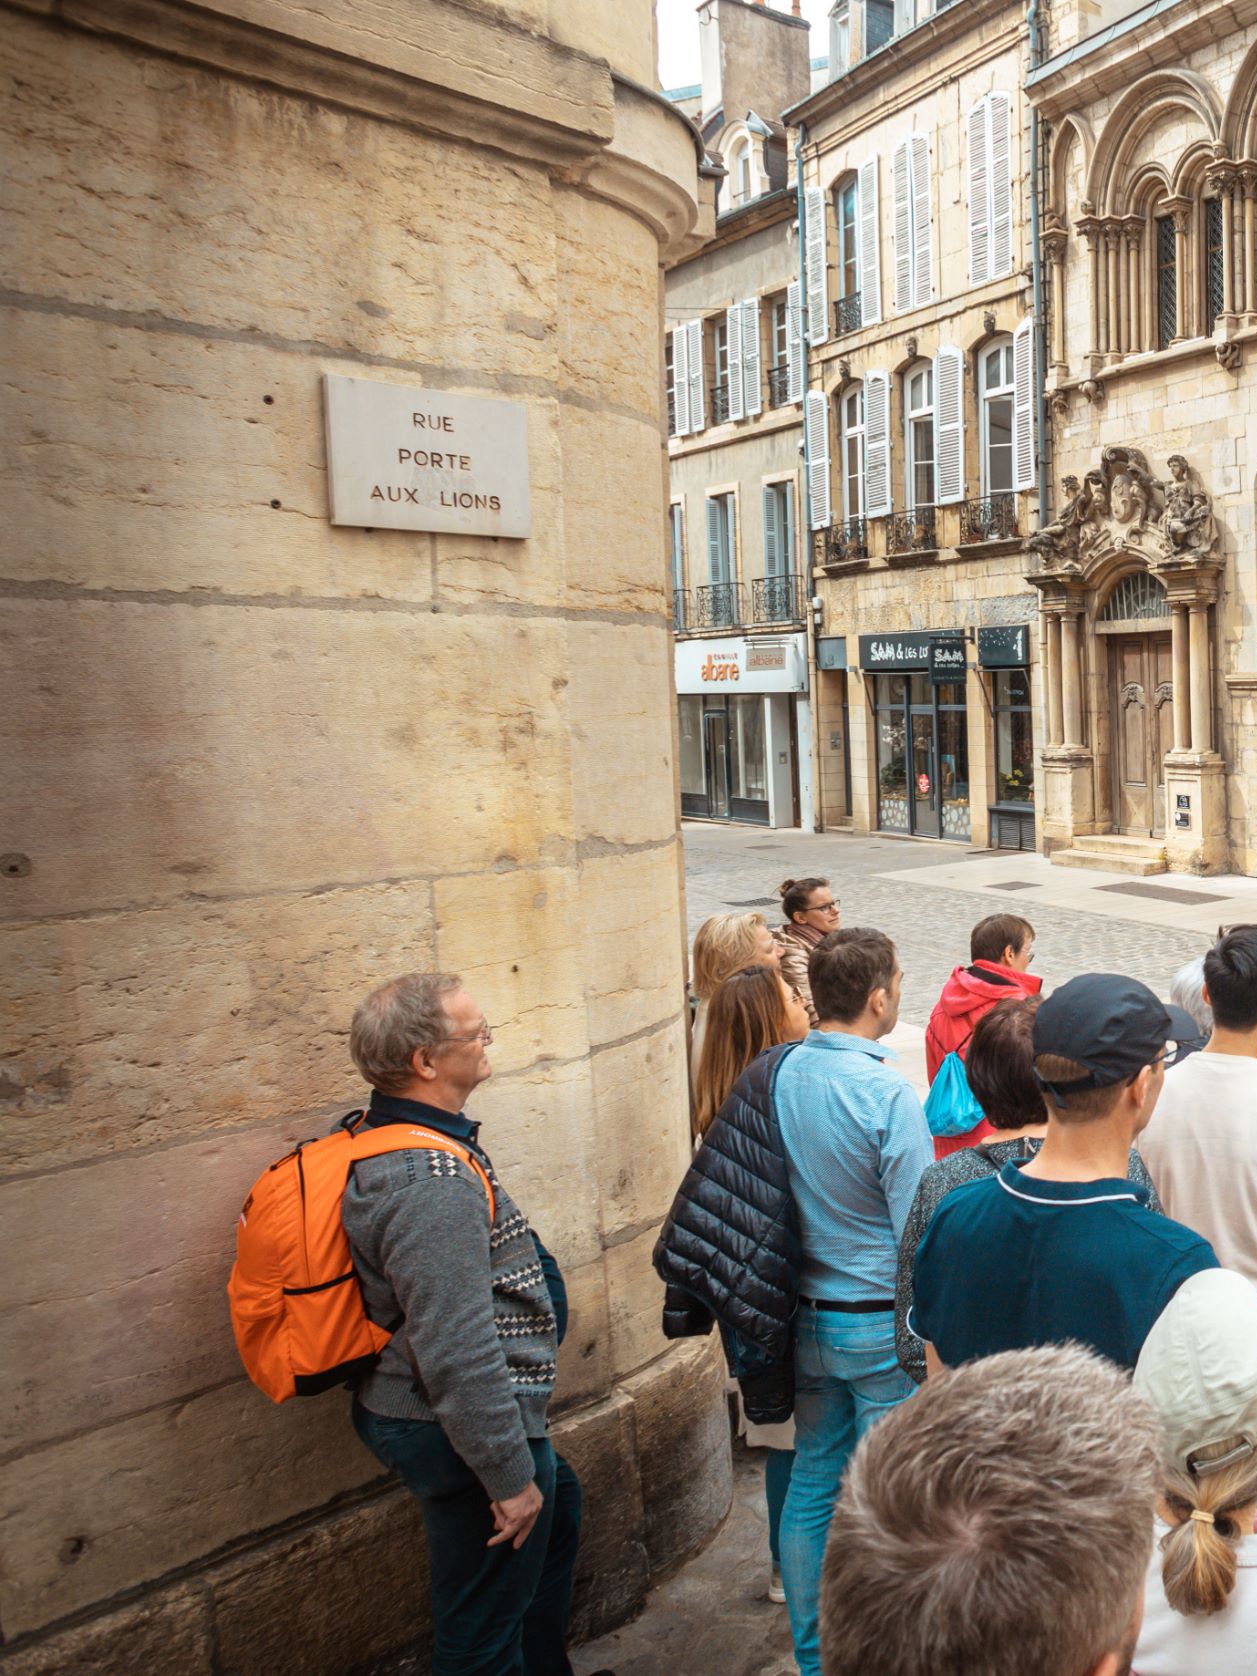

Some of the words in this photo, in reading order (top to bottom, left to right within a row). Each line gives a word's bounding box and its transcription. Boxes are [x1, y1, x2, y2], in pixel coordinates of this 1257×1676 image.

[412, 412, 455, 433] RUE
[398, 448, 471, 471] PORTE
[370, 485, 419, 504] AUX
[440, 491, 501, 511] LIONS
[870, 642, 895, 661] SAM
[896, 643, 904, 660] &
[934, 648, 964, 662] SAM
[701, 654, 740, 682] albane
